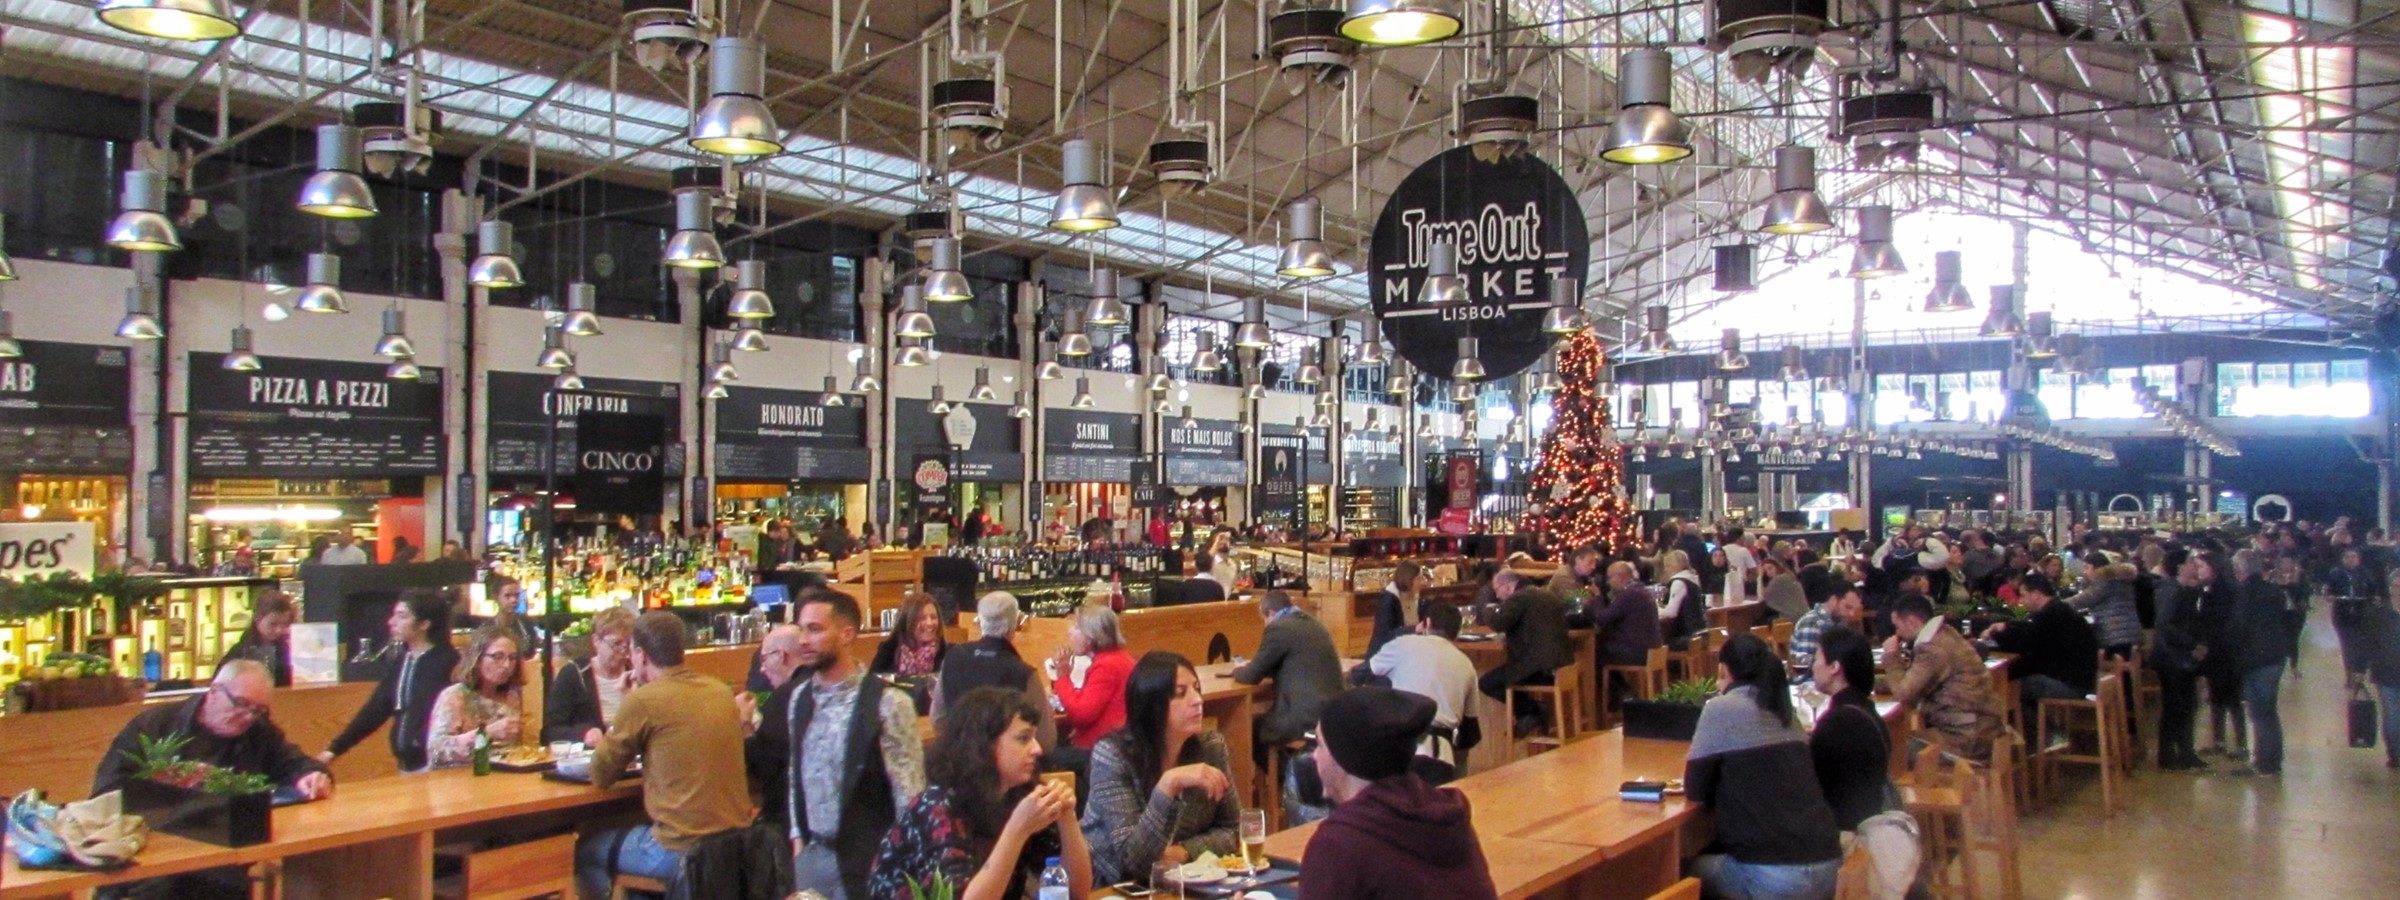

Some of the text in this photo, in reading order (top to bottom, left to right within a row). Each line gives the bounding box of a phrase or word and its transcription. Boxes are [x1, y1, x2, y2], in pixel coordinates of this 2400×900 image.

[1403, 202, 1541, 268] Time Out
[1385, 266, 1568, 304] MRKET
[1442, 304, 1506, 321] LISBOA
[250, 376, 389, 407] PIZZA A PEZZI
[761, 403, 824, 426] HONORATO
[1076, 422, 1109, 440] SANTINI
[1193, 429, 1210, 446] MAIS
[583, 451, 652, 471] CINCO
